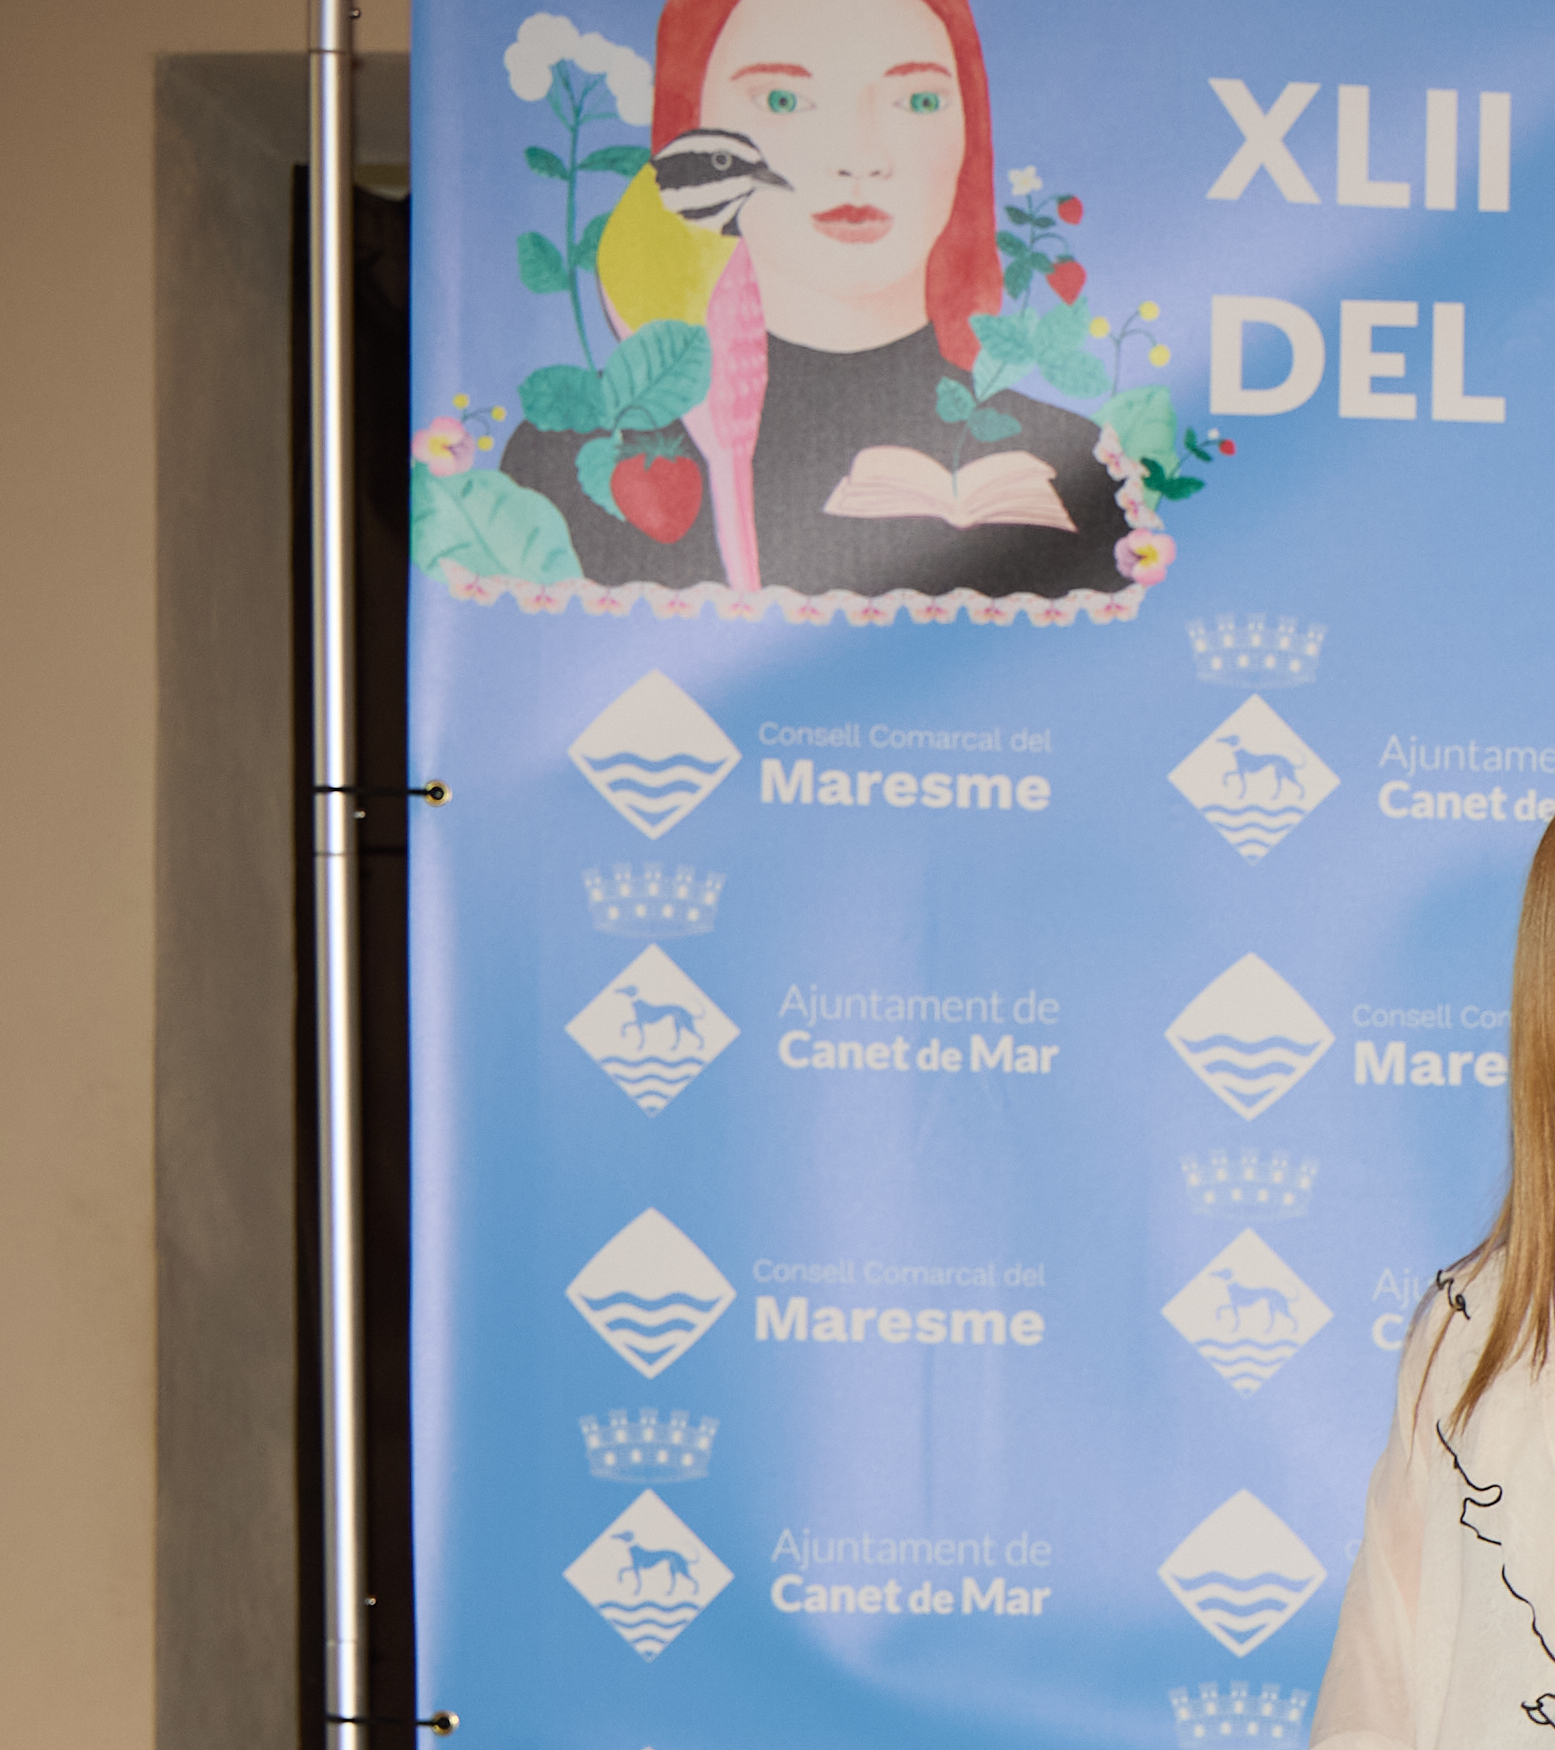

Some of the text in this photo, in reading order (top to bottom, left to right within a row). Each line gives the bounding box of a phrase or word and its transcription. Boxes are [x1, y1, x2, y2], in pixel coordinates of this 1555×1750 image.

[1206, 78, 1511, 213] XLII
[1208, 293, 1507, 424] DEL
[758, 720, 1053, 755] Consell Comarcal del
[759, 758, 1052, 812] Maresme
[1377, 782, 1555, 822] Canet de
[778, 983, 1060, 1028] Ajuntament de
[1352, 1003, 1452, 1029] Consell
[778, 1030, 1060, 1075] Canet de Mar
[1354, 1040, 1508, 1086] Mare
[752, 1258, 1046, 1290] Consell Comarcal del
[754, 1296, 1046, 1347] Maresme
[771, 1528, 1053, 1570] Ajuntament de
[770, 1573, 1052, 1616] Canet de Mar
